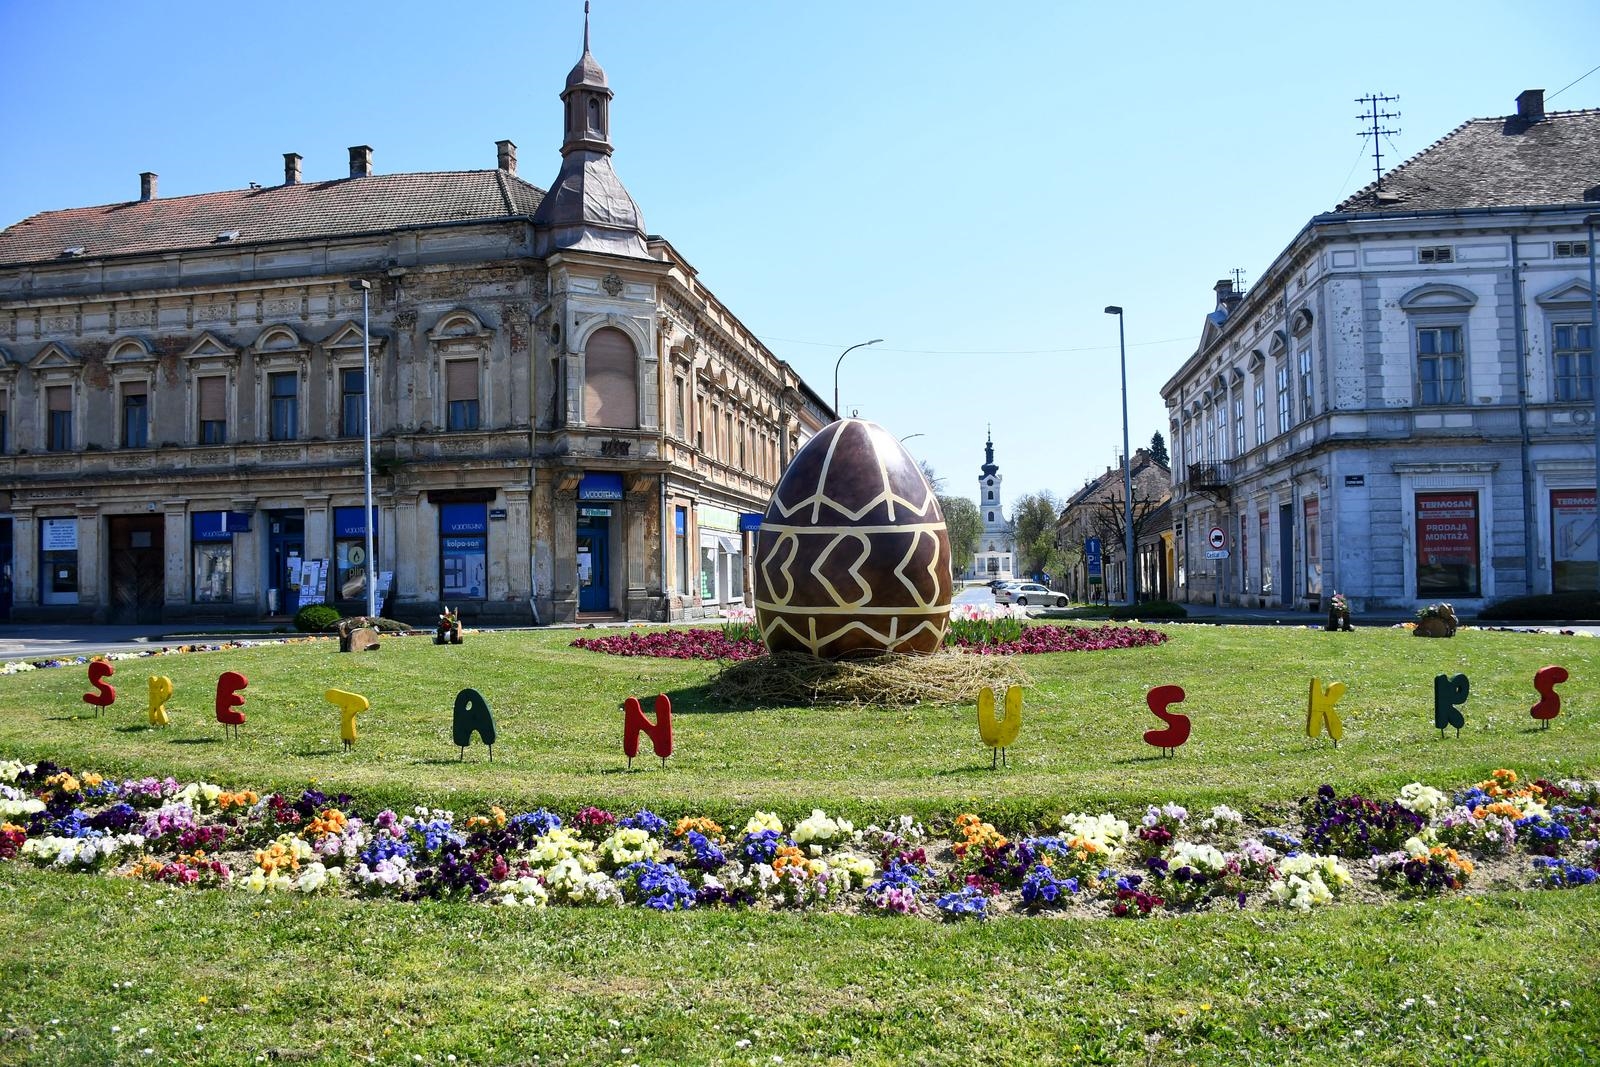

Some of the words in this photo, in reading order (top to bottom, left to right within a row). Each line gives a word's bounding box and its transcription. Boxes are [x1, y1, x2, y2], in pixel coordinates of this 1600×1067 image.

[1420, 499, 1472, 508] TERMOSAN
[1425, 531, 1469, 541] MONTAŽA
[83, 661, 673, 758] SRETAN
[977, 664, 1568, 748] USKRS
